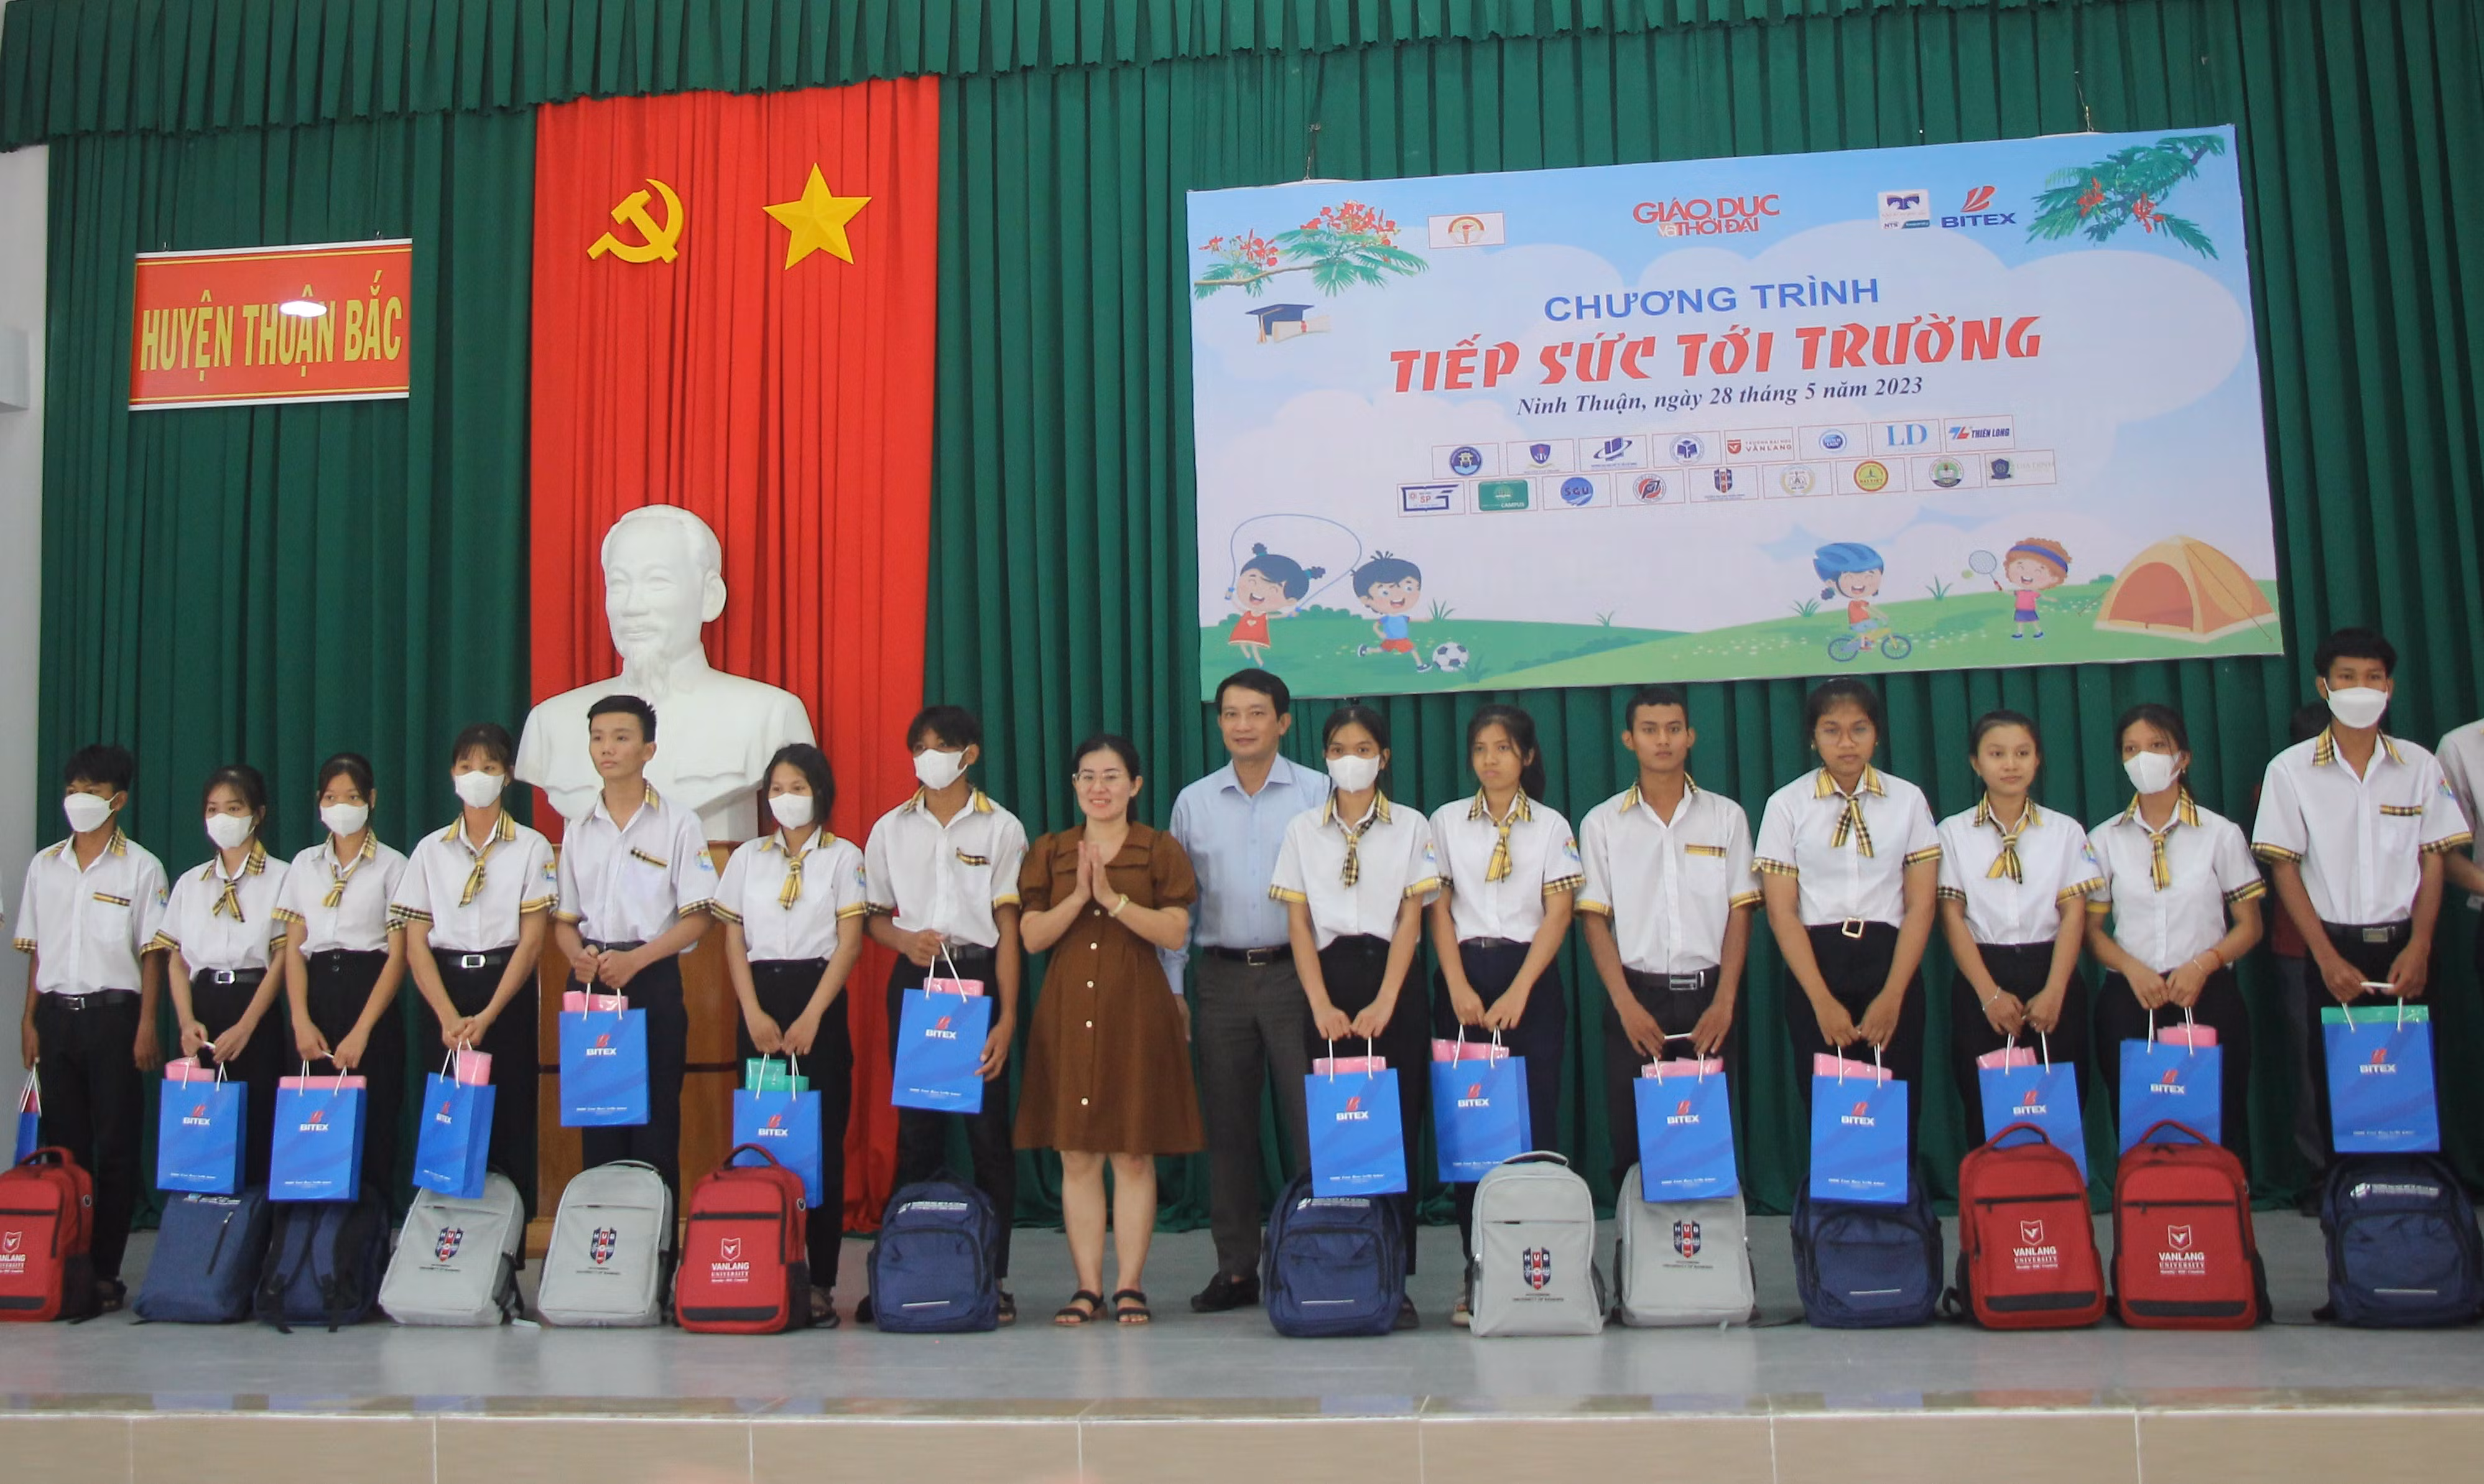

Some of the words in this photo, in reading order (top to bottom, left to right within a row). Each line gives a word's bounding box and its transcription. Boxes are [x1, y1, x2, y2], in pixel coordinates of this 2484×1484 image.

[1633, 197, 1712, 223] GIÁO
[1941, 212, 2016, 228] BITEX
[1544, 287, 1736, 321] CHƯƠNG
[1751, 276, 1878, 308] TRÌNH
[141, 289, 234, 381] HUYỆN
[243, 284, 336, 377] THUẬN
[344, 270, 402, 361] BẮC
[1391, 333, 1520, 392] TIẾP
[1539, 332, 1656, 384] SỨC
[1677, 325, 1774, 376] TỚI
[1796, 313, 2041, 369] TRƯỜNG
[1517, 397, 1566, 415] Ninh
[1576, 393, 1646, 414] Thuận,
[1654, 390, 1702, 409] ngày
[1710, 386, 1732, 404] 28
[1740, 382, 1797, 405] tháng
[1805, 383, 1816, 399] 5
[1823, 381, 1866, 398] năm
[1875, 377, 1923, 396] 2023
[1886, 424, 1927, 446] LD
[1565, 487, 1589, 496] SGU
[925, 1029, 956, 1039] BITEX
[586, 1047, 617, 1055] BITEX
[2360, 1064, 2396, 1074] BITEX
[2150, 1083, 2185, 1094] BITEX
[1458, 1098, 1490, 1107] BITEX
[2013, 1105, 2047, 1115] BITEX
[183, 1117, 211, 1125] BITEX
[1336, 1111, 1368, 1121] BITEX
[1667, 1114, 1699, 1125] BITEX
[1841, 1115, 1875, 1126] BITEX
[758, 1128, 788, 1136] BITEX
[2013, 1246, 2057, 1256] VANLANG
[2158, 1252, 2205, 1261] VANLANG
[711, 1263, 749, 1271] VANLANG
